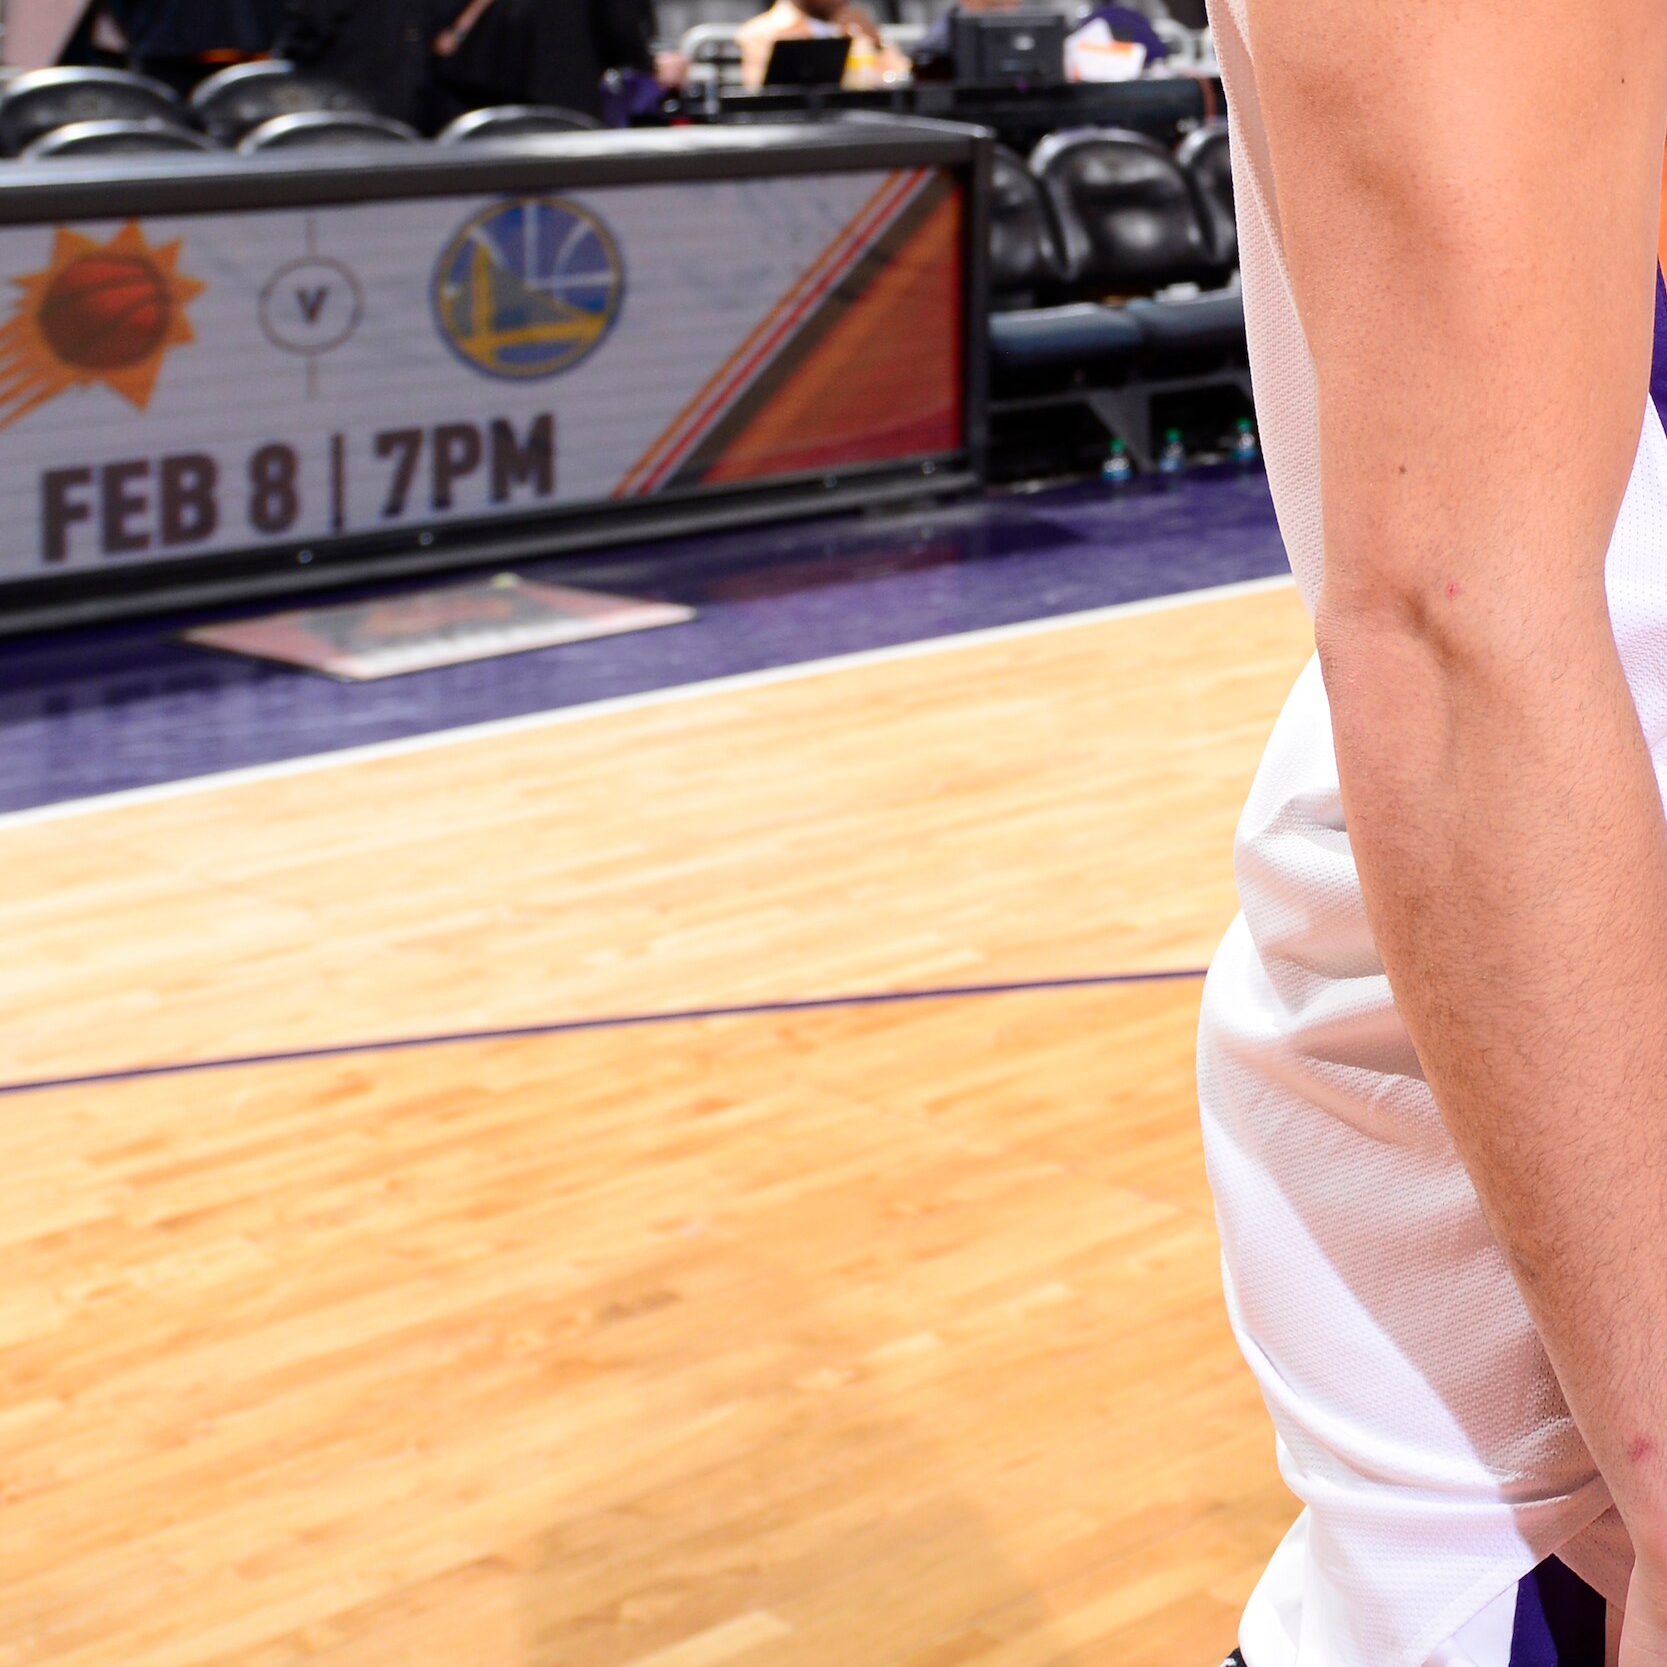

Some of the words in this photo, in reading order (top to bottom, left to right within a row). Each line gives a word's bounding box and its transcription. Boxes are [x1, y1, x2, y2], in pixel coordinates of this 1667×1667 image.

[41, 452, 220, 564] FEB
[248, 442, 300, 535] 8
[373, 411, 557, 520] 7PM
